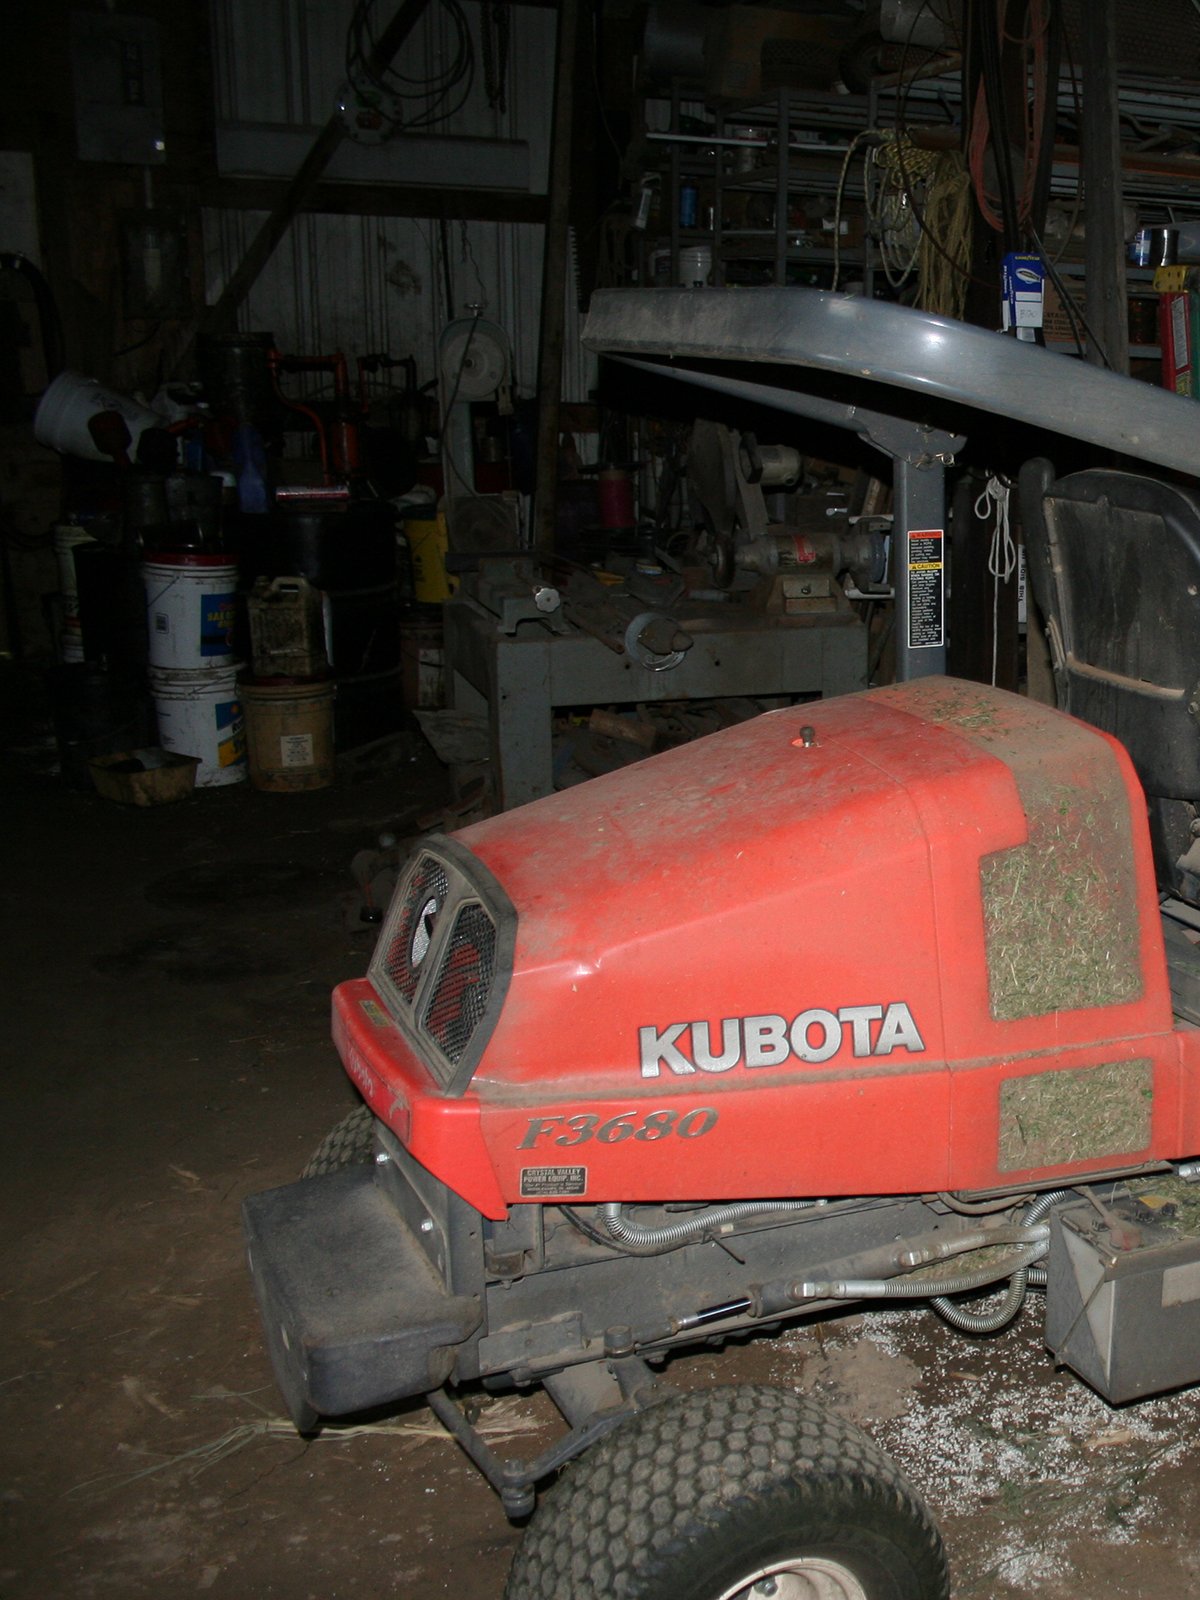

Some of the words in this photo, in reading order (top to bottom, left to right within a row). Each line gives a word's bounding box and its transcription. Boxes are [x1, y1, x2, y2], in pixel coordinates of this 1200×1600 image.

[638, 1002, 926, 1079] KUBOTA
[516, 1107, 719, 1150] F3680
[523, 1175, 547, 1183] POWER
